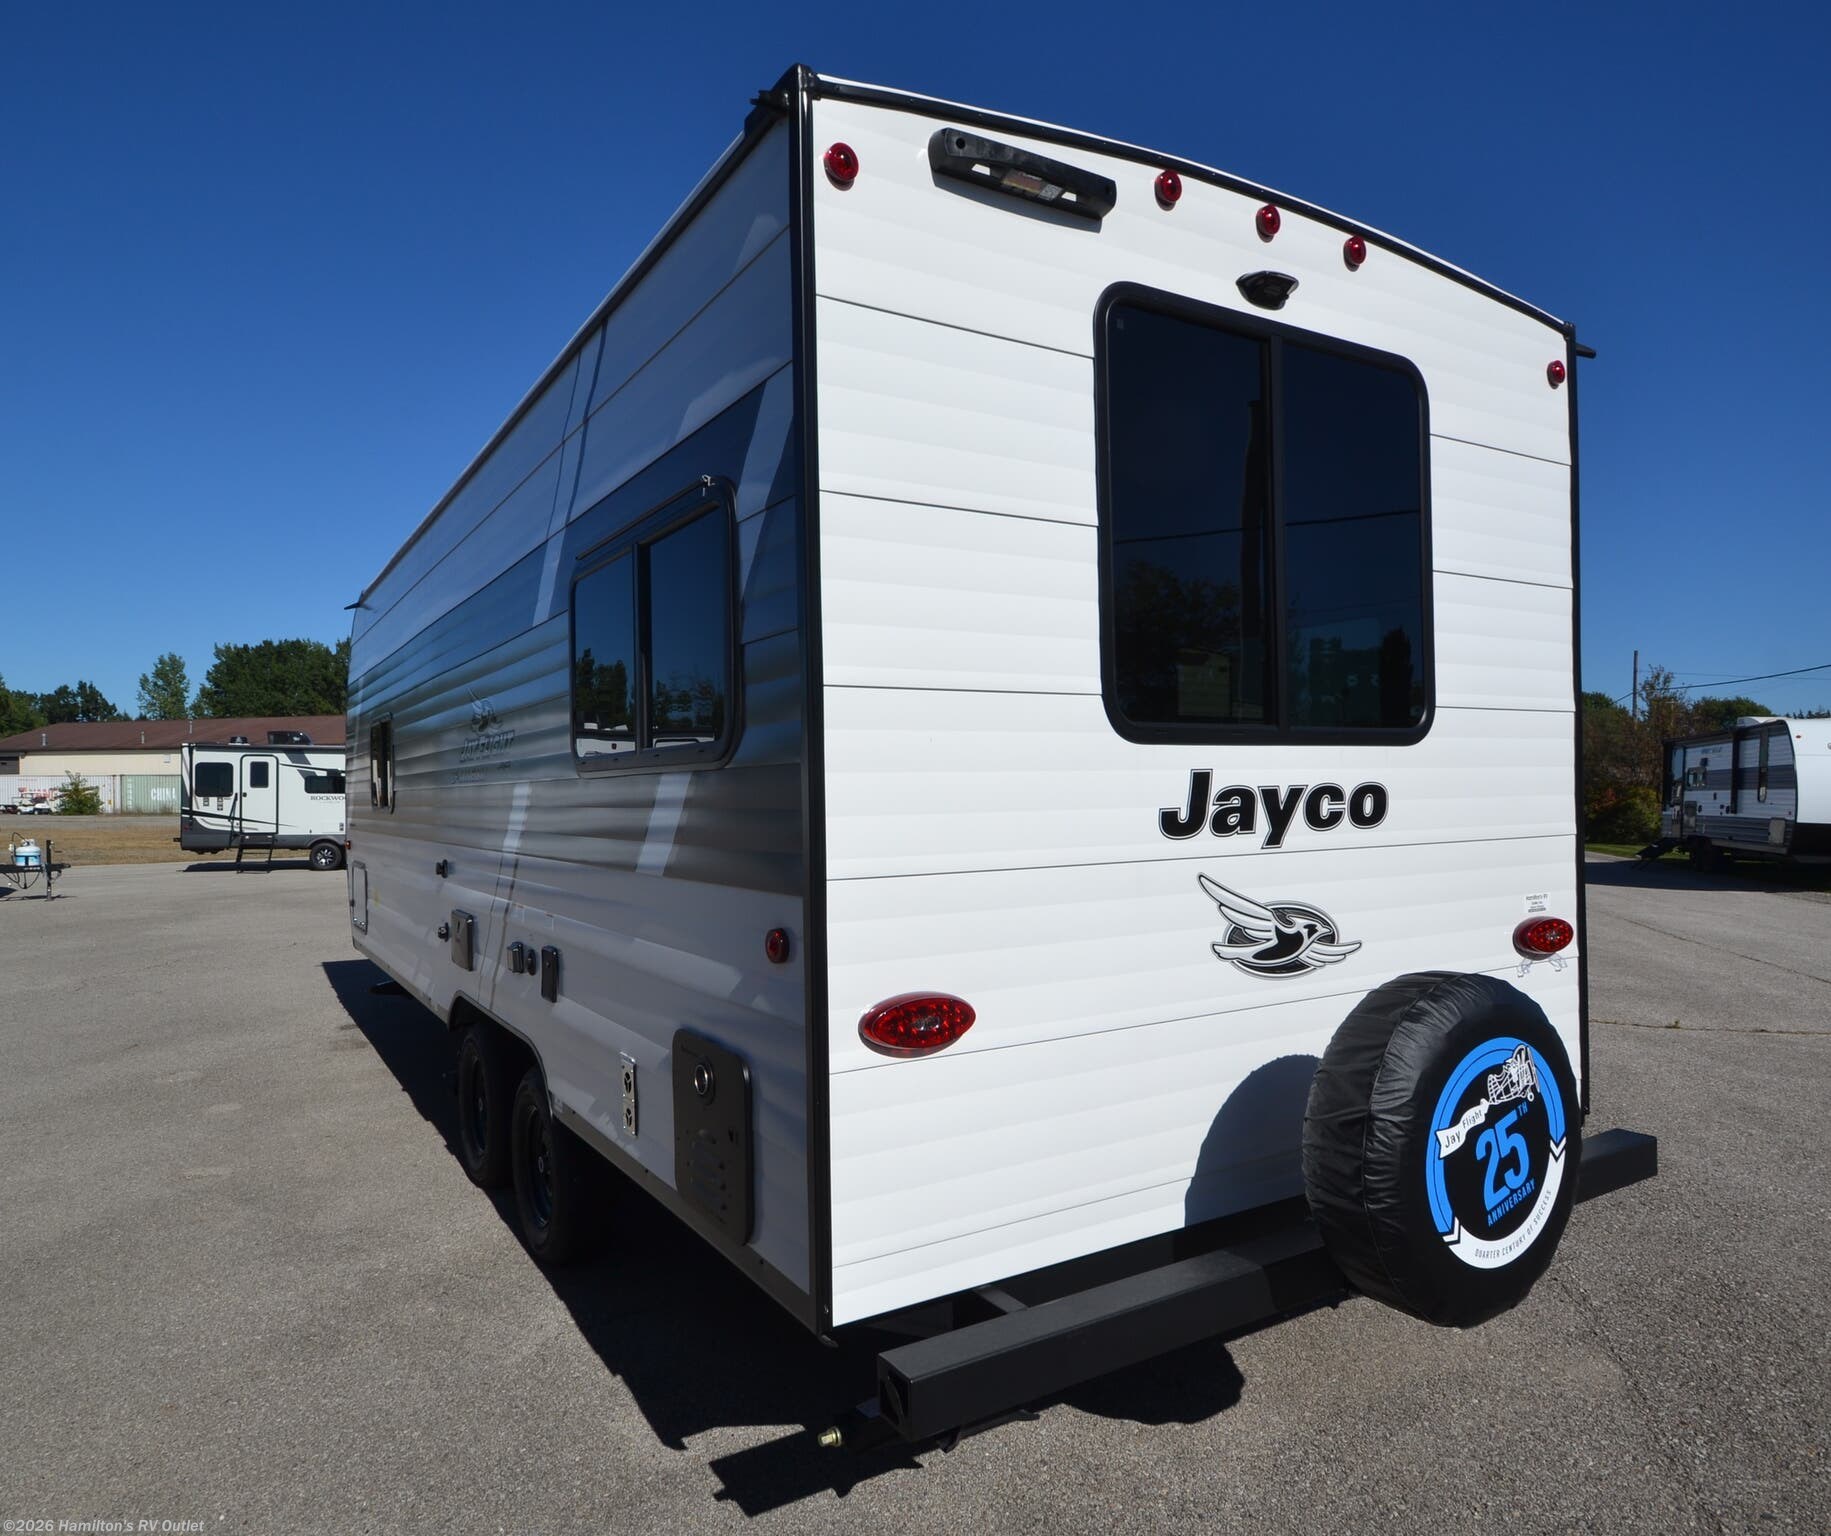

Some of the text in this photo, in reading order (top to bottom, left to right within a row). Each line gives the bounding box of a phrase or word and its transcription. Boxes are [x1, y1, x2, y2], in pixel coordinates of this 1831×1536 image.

[1158, 769, 1389, 849] Jayco
[1445, 1109, 1482, 1148] Jay Flight
[1475, 1189, 1552, 1259] QUARTER CENTURY OF SUCCESS
[1487, 1178, 1535, 1227] ANNIVERSARY
